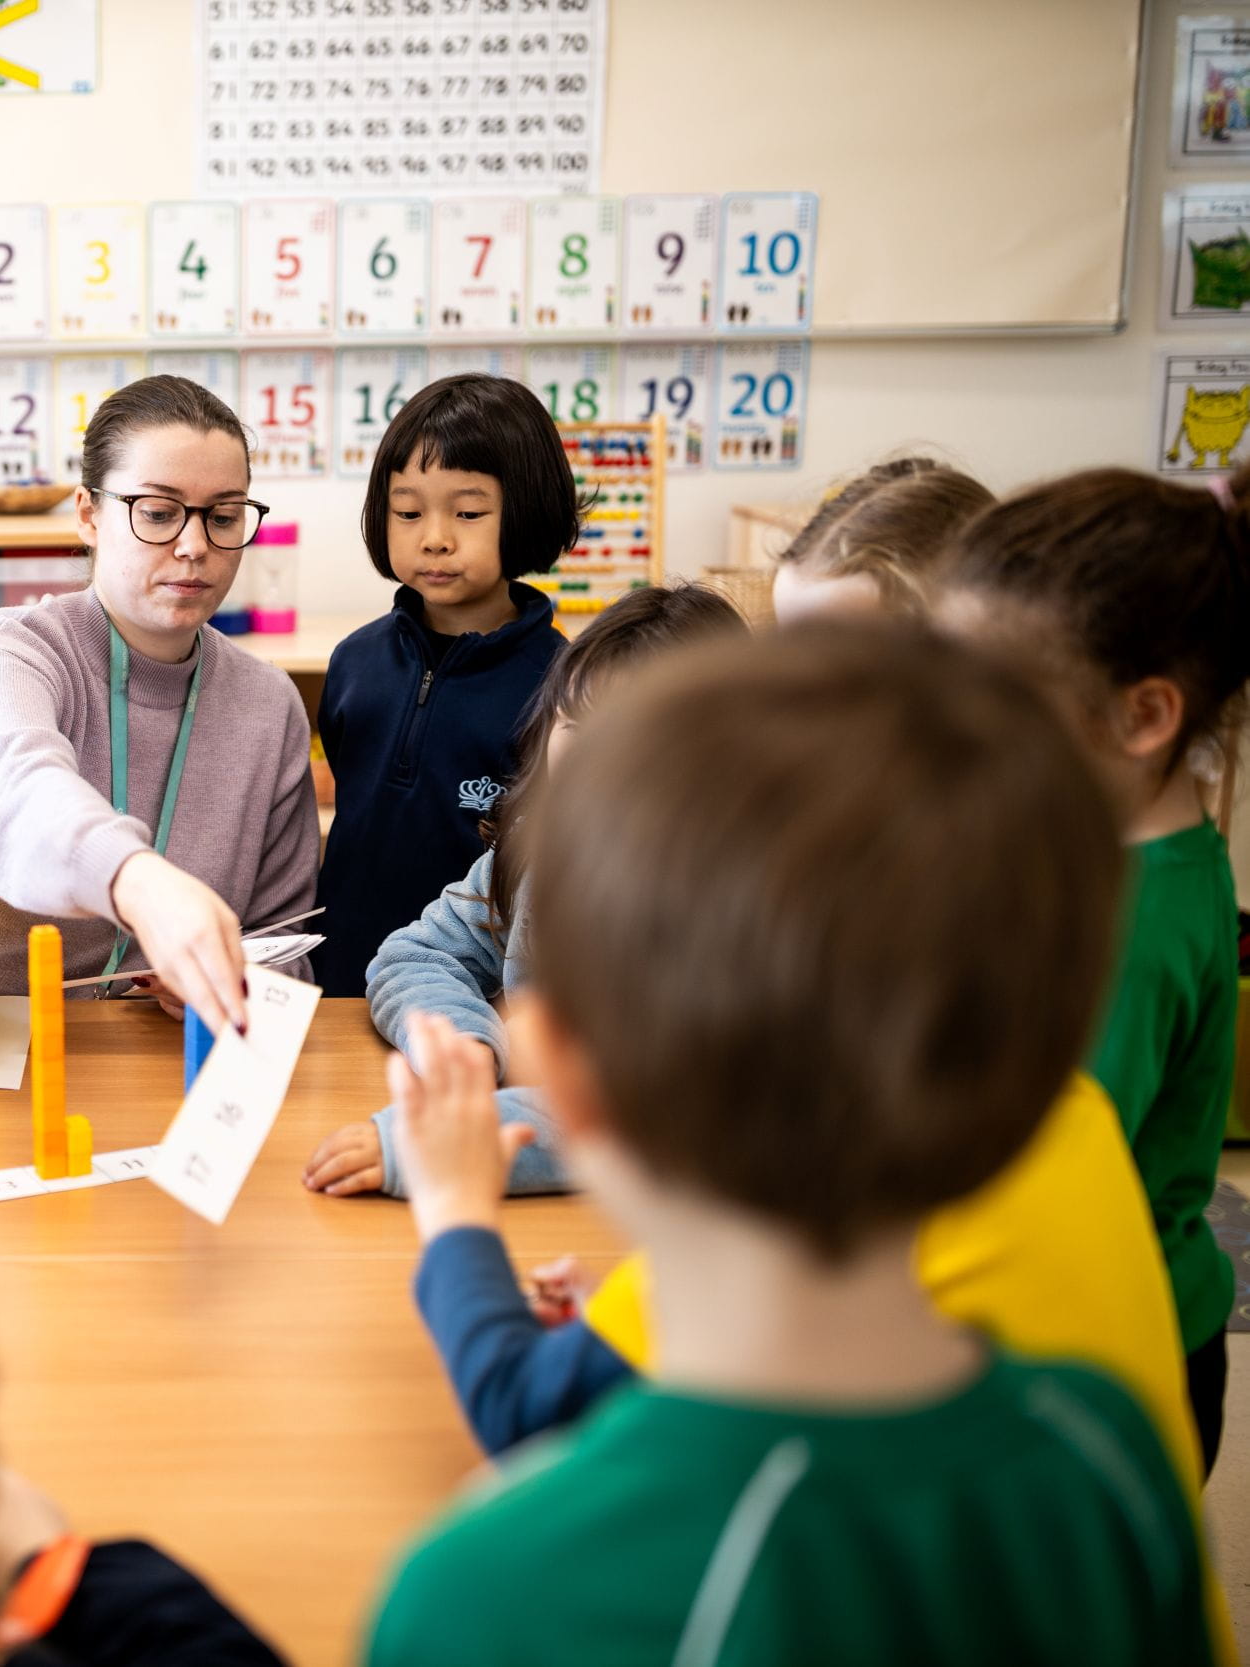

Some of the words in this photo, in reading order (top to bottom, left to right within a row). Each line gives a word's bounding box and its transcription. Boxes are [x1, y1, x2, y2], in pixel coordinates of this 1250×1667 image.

[209, 40, 237, 60] 61
[250, 39, 277, 59] 62
[288, 38, 315, 57] 63
[326, 37, 353, 56] 64
[365, 37, 392, 56] 65
[404, 35, 430, 54] 66
[442, 34, 469, 54] 67
[482, 33, 509, 53] 68
[520, 33, 548, 53] 69
[558, 33, 588, 52] 70
[210, 80, 237, 100] 71
[250, 80, 277, 100] 72
[288, 79, 315, 98] 73
[326, 78, 353, 97] 74
[365, 78, 392, 97] 75
[404, 77, 429, 96] 76
[442, 76, 469, 95] 77
[481, 75, 508, 95] 78
[520, 75, 547, 94] 79
[556, 74, 587, 94] 80
[209, 120, 237, 139] 81
[249, 120, 276, 139] 82
[325, 119, 352, 137] 84
[440, 116, 467, 135] 87
[517, 115, 544, 133] 89
[555, 114, 584, 132] 90
[209, 158, 237, 176] 91
[248, 158, 276, 177] 92
[324, 156, 352, 174] 94
[439, 154, 466, 172] 97
[515, 153, 543, 172] 99
[552, 152, 588, 171] 100
[85, 240, 111, 284] 3
[179, 239, 208, 281] 4
[275, 238, 301, 281] 5
[370, 236, 398, 279] 6
[465, 236, 494, 278] 7
[558, 233, 589, 278] 8
[656, 232, 685, 276] 9
[740, 231, 802, 276] 10
[70, 388, 116, 432] 1
[260, 384, 316, 427] 15
[543, 378, 599, 421] 18
[639, 376, 694, 420] 19
[730, 372, 793, 417] 20
